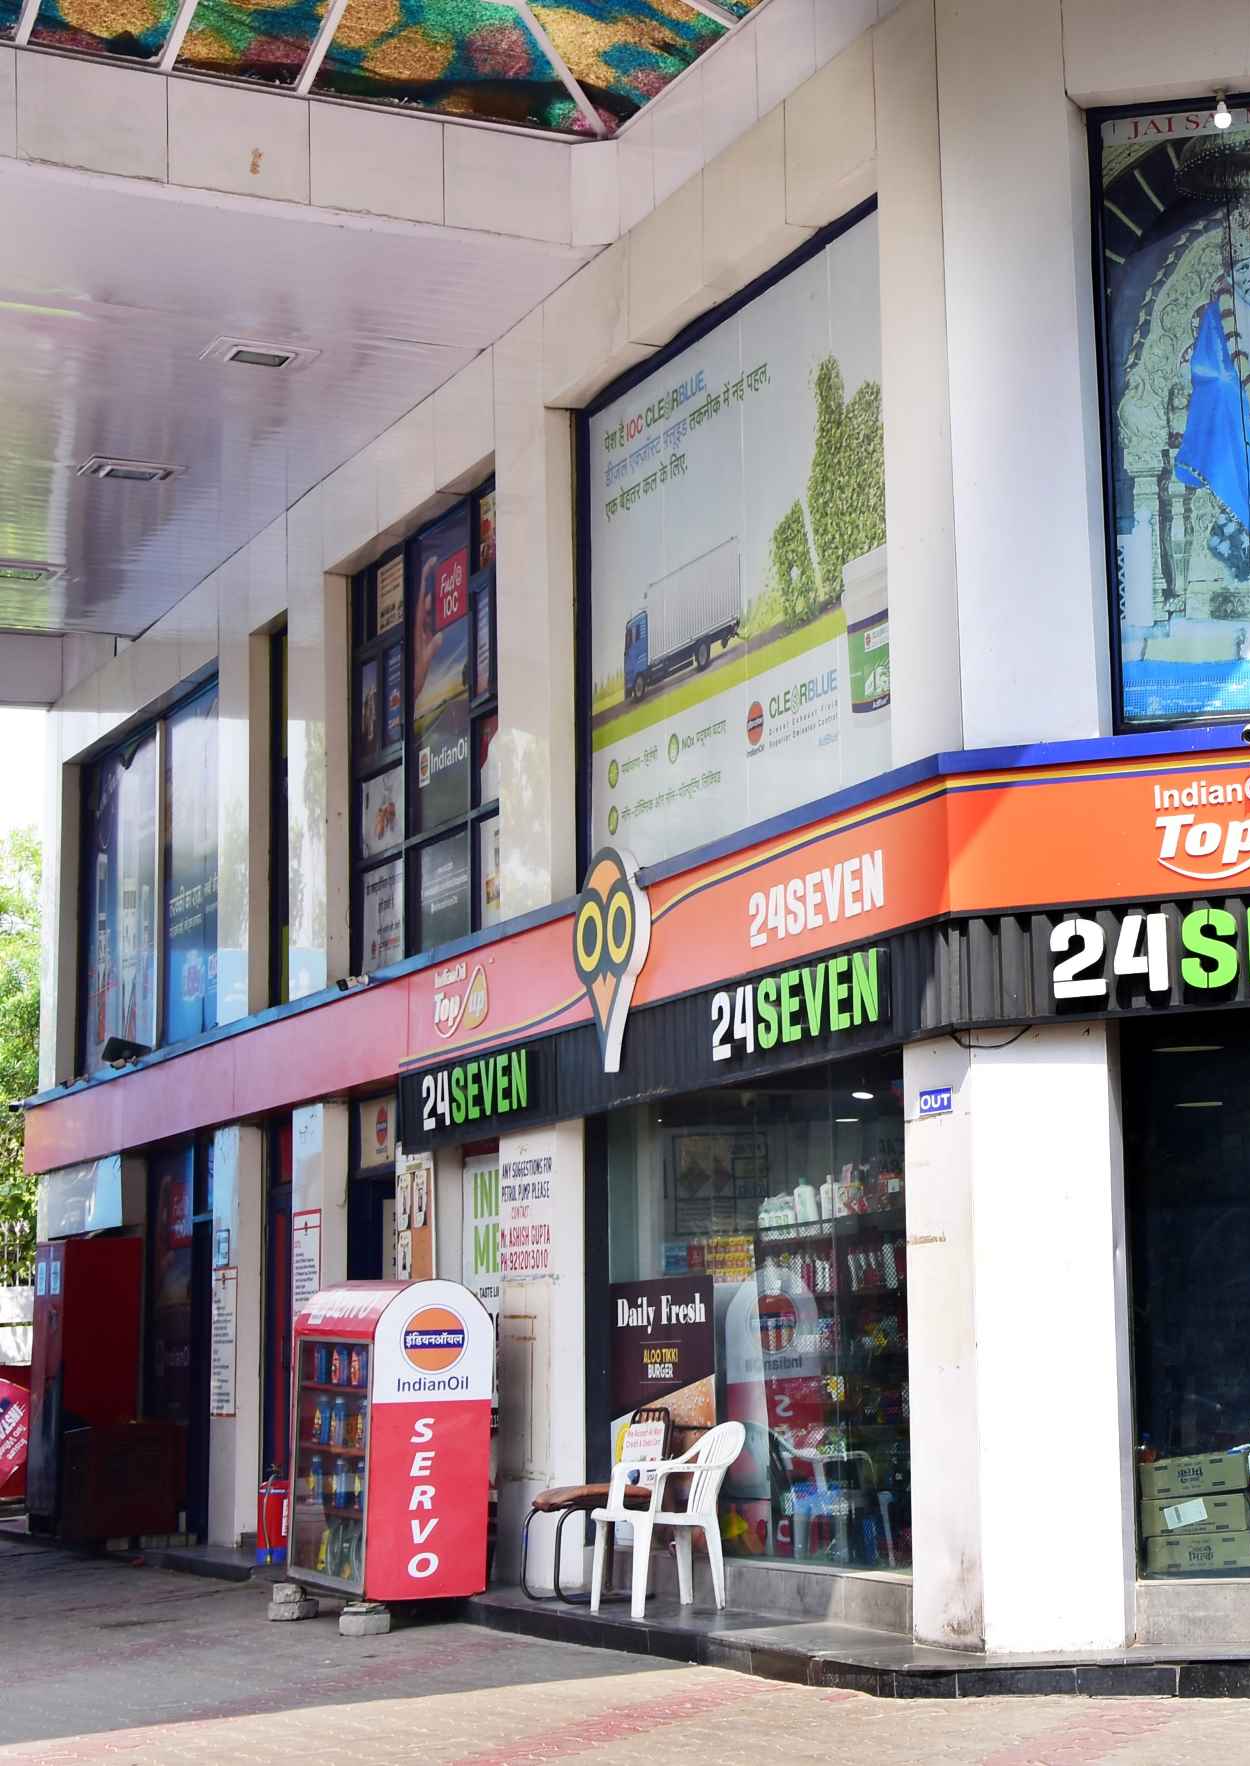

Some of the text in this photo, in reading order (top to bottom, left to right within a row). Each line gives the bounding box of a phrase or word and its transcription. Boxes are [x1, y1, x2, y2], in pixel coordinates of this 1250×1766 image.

[1128, 119, 1175, 141] JAI
[1184, 111, 1233, 130] SA
[626, 414, 644, 442] IOC
[443, 591, 459, 618] IOC
[748, 849, 885, 949] 24SEVEN
[434, 991, 460, 1027] Top
[711, 948, 880, 1062] 24SEVEN
[421, 1049, 528, 1131] 24SEVEN
[921, 1093, 951, 1111] OUT
[531, 1181, 550, 1200] PLEASE
[508, 1225, 530, 1248] ASHISH
[530, 1223, 550, 1246] GUPTA
[616, 1292, 706, 1335] Daily Fresh
[405, 1332, 464, 1348] इंडियनऑयल
[397, 1376, 469, 1393] IndianOil
[647, 1363, 674, 1379] BURGER
[406, 1416, 440, 1579] SERVO
